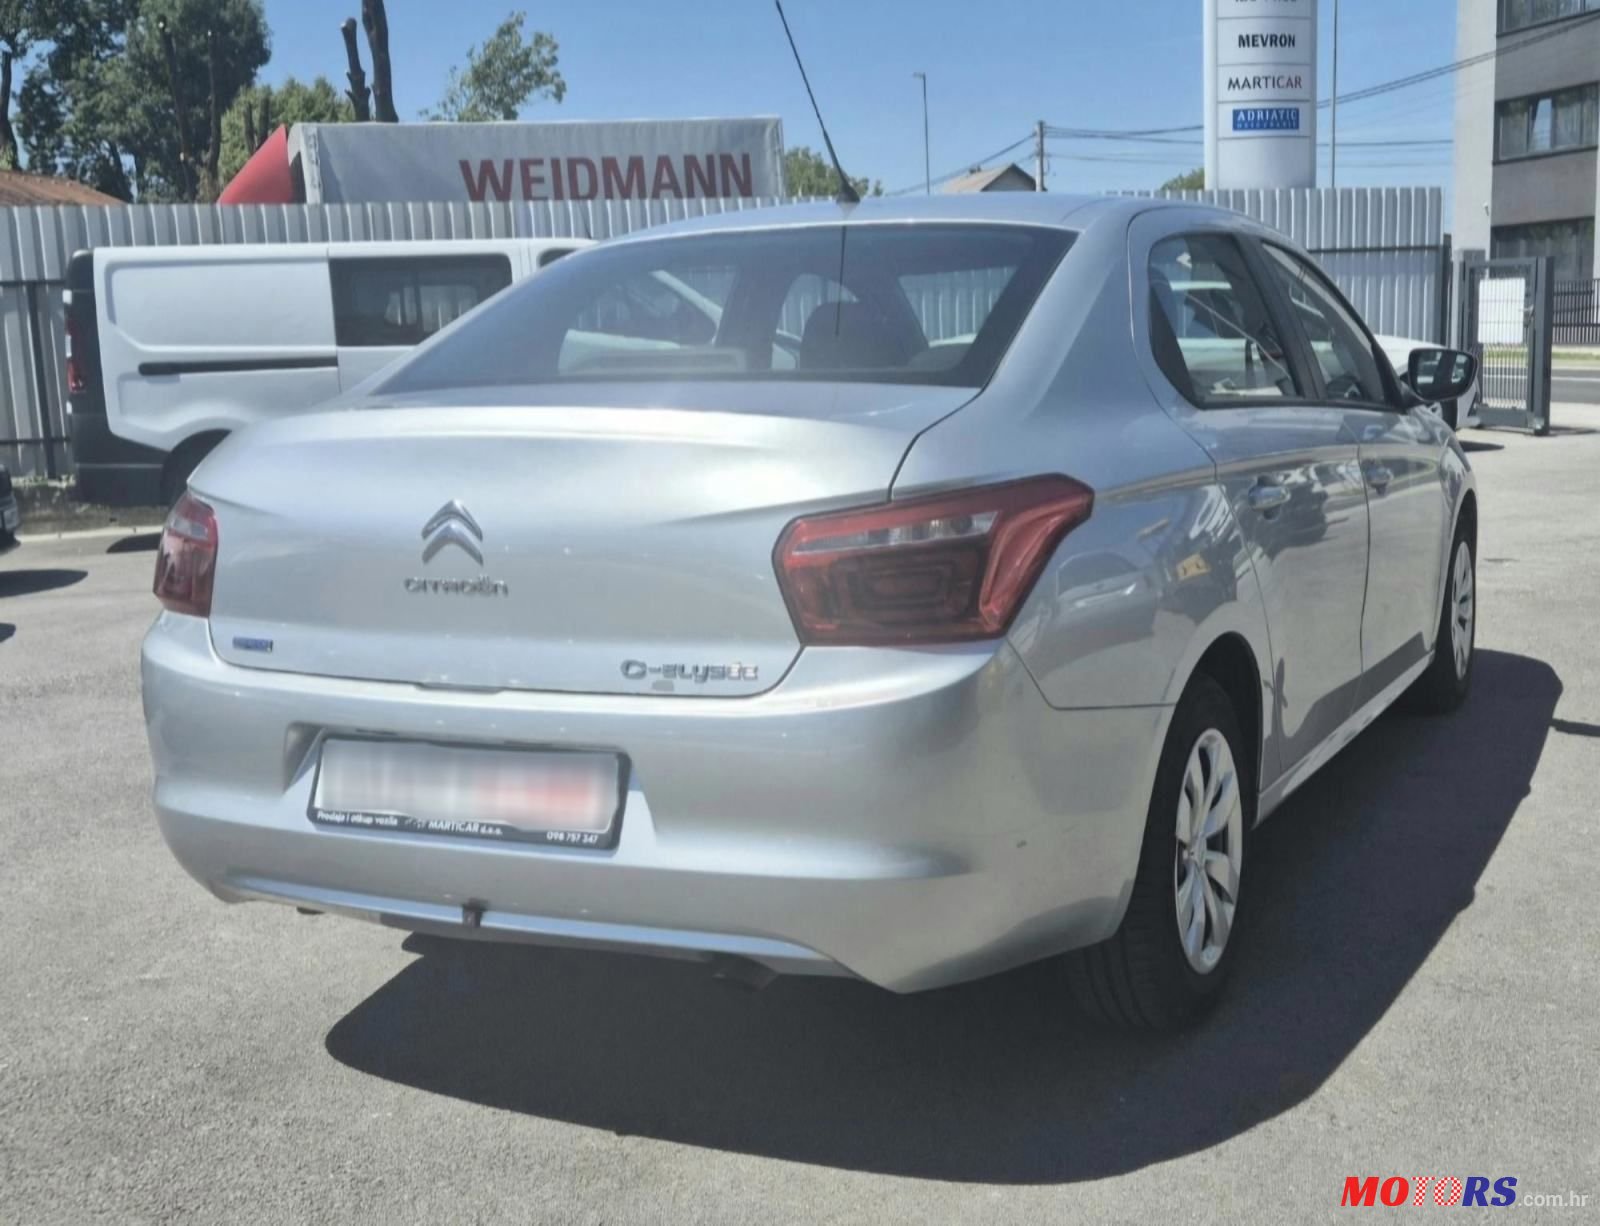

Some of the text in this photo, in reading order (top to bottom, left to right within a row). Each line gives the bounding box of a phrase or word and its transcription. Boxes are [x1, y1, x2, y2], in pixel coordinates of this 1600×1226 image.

[1238, 33, 1296, 49] MEVRON
[1227, 75, 1303, 91] MARTICAR
[1236, 109, 1297, 121] ADRIATIC
[458, 153, 753, 202] WEIDMANN
[428, 819, 479, 834] MARTICAR
